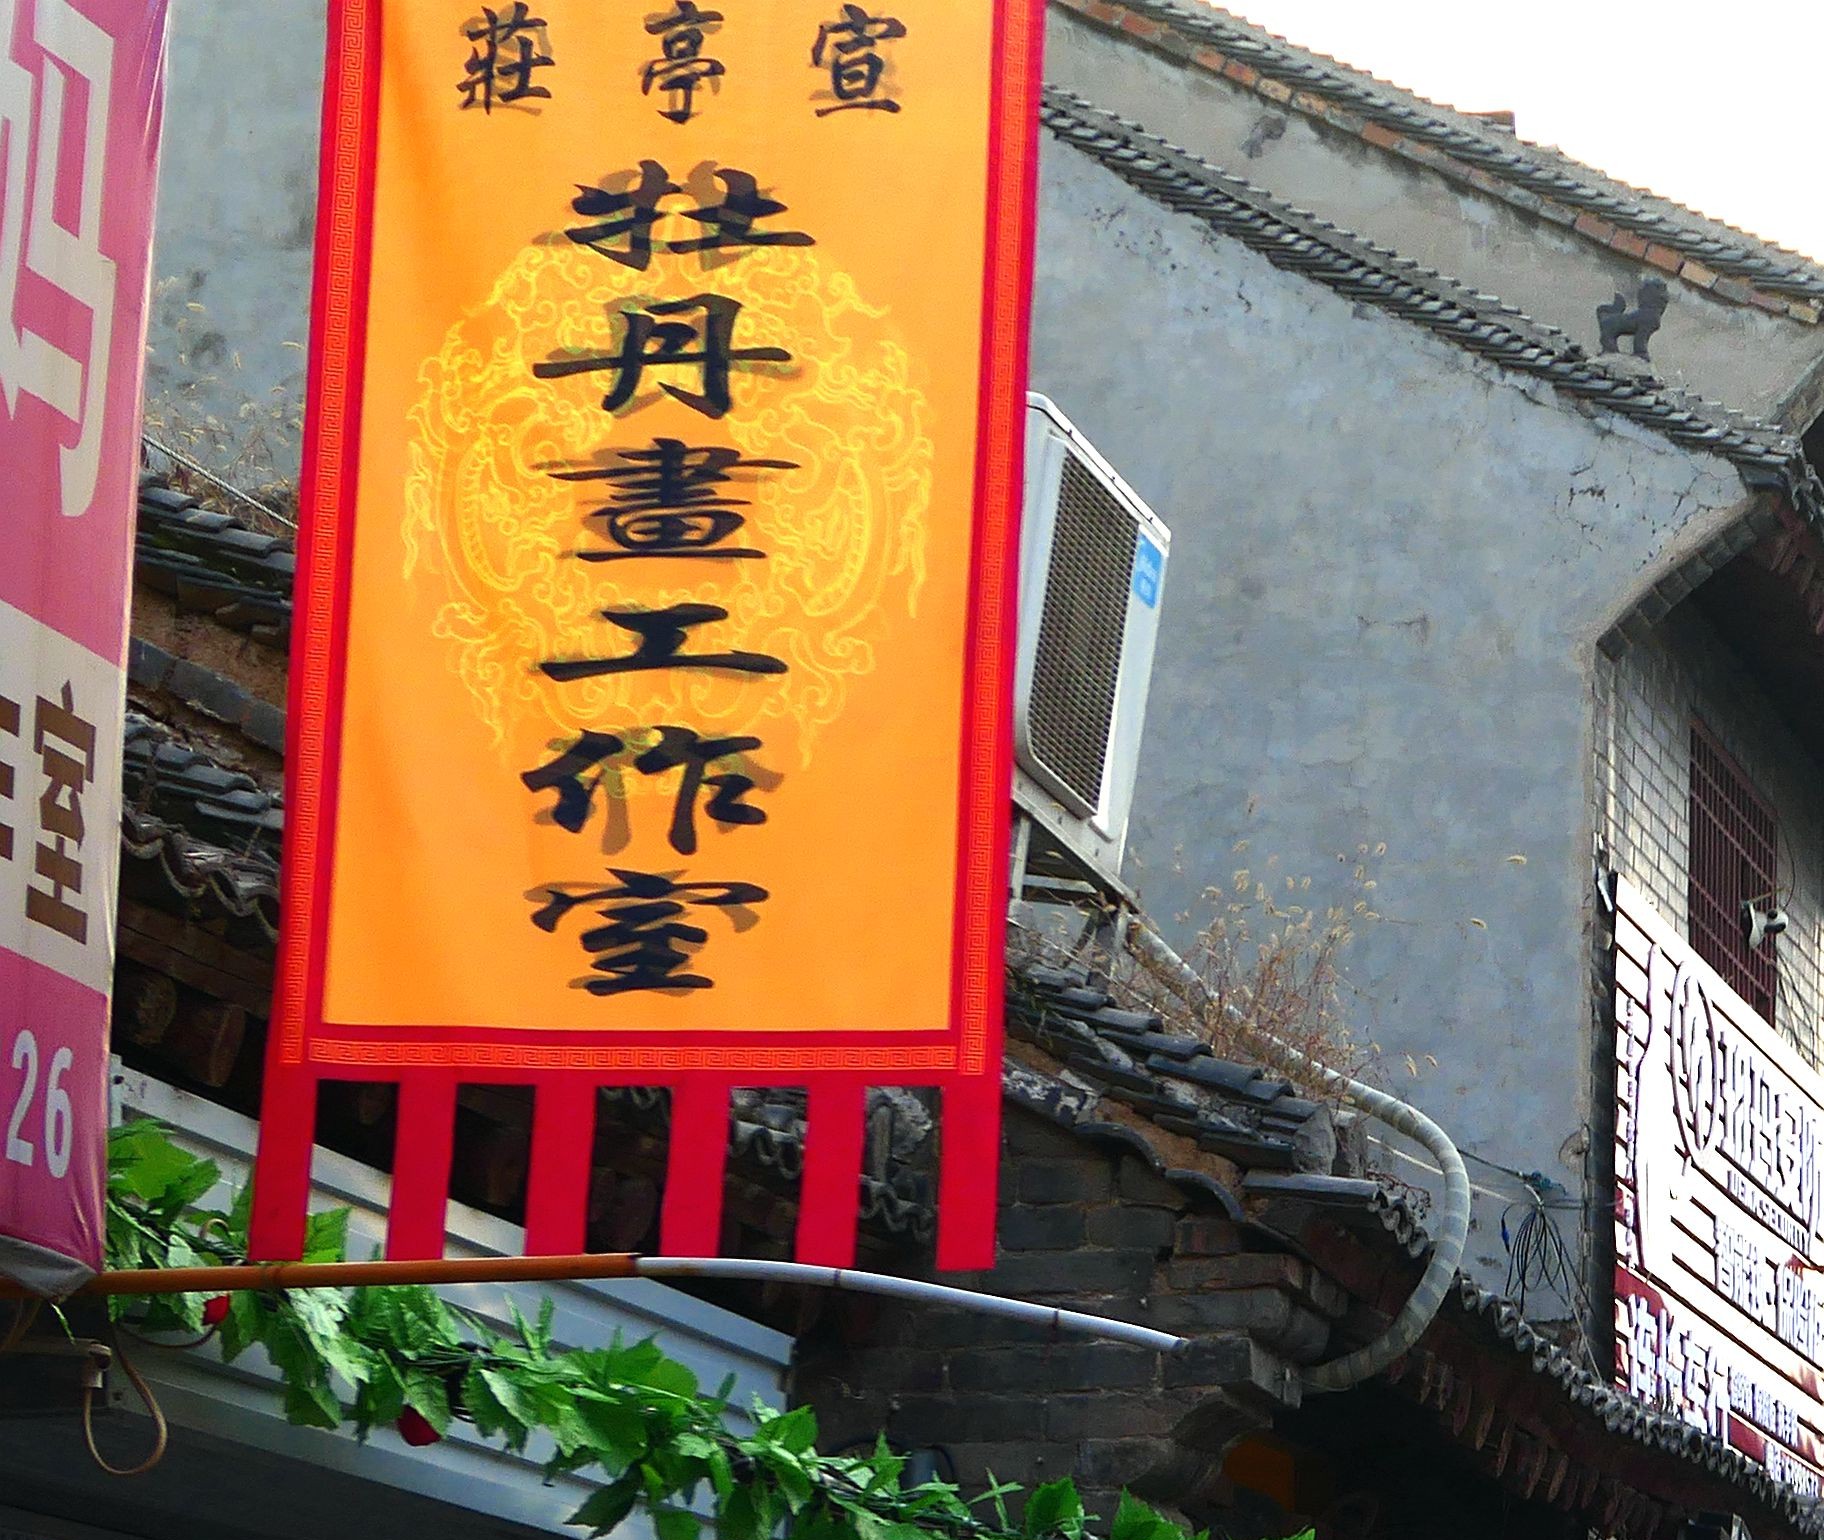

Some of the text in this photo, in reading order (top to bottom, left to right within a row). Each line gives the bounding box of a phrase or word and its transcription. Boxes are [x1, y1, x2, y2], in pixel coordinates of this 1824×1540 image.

[520, 156, 818, 999] 牡丹畫工作室
